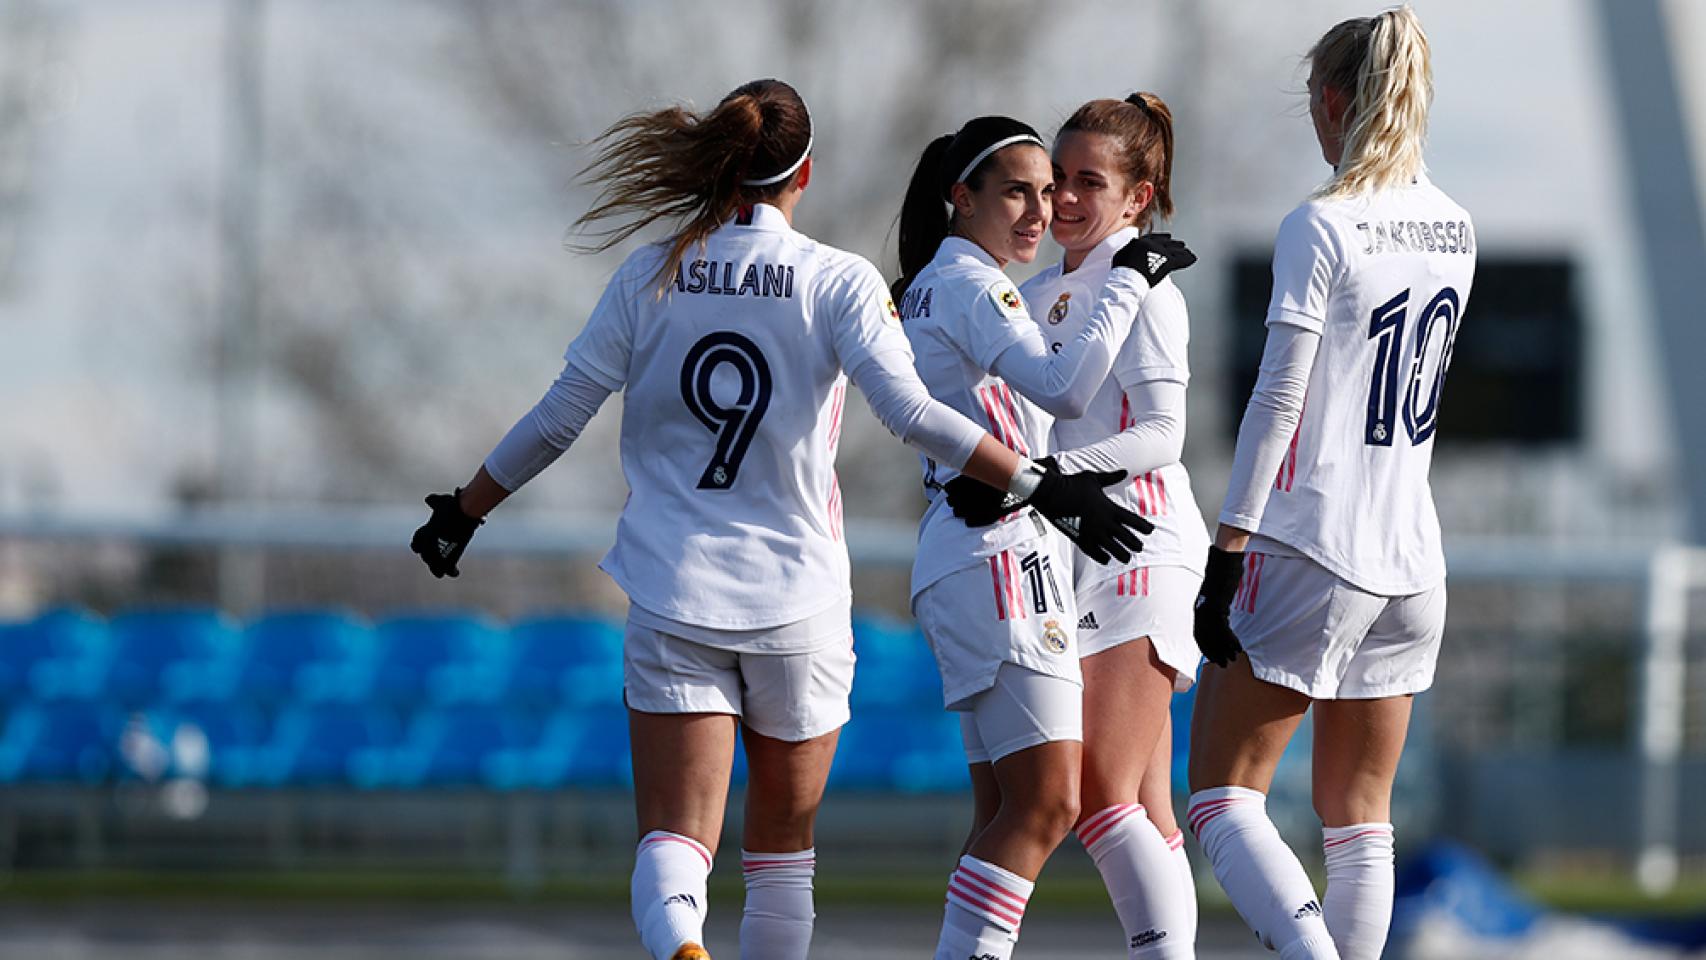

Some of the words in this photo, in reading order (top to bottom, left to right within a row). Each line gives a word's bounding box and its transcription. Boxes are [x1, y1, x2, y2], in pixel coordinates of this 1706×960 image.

[1356, 220, 1473, 254] JAKOBSSO
[680, 331, 773, 490] 9
[1365, 287, 1460, 447] 10
[1020, 550, 1064, 614] 11
